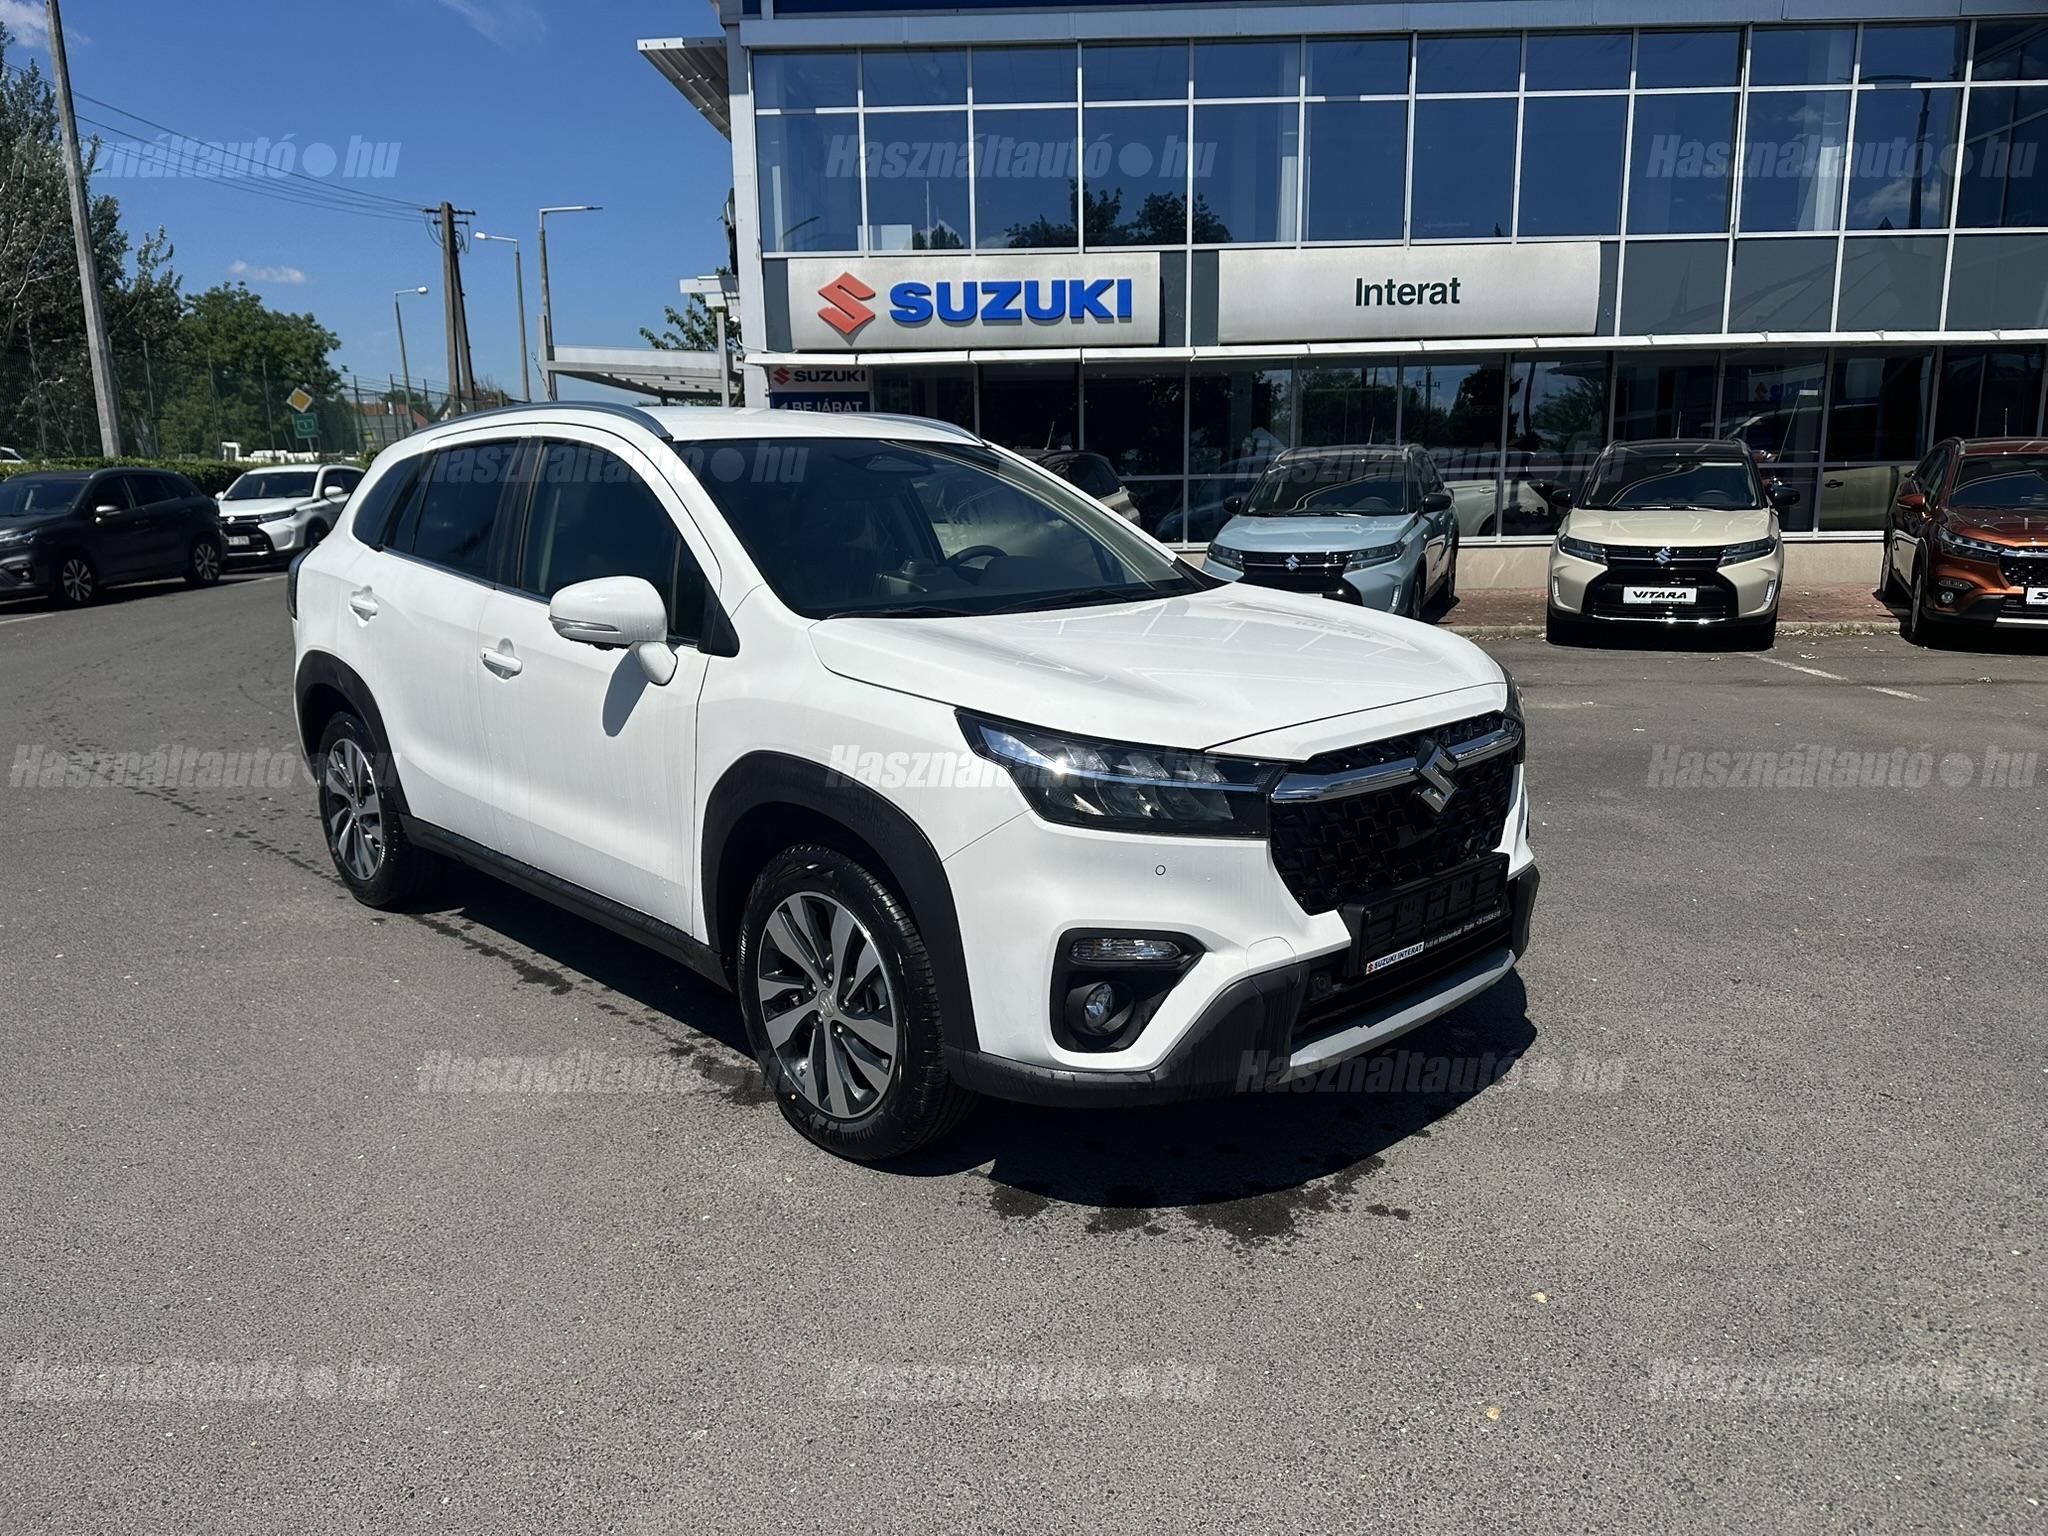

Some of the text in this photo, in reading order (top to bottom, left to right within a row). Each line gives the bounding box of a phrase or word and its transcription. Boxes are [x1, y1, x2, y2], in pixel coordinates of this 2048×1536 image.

[889, 278, 1133, 325] SUZUKI
[1354, 276, 1461, 307] Interat
[793, 369, 866, 383] SUZUKI
[1632, 590, 1687, 600] VITARA
[1374, 943, 1423, 970] SUZUKI INTERAT
